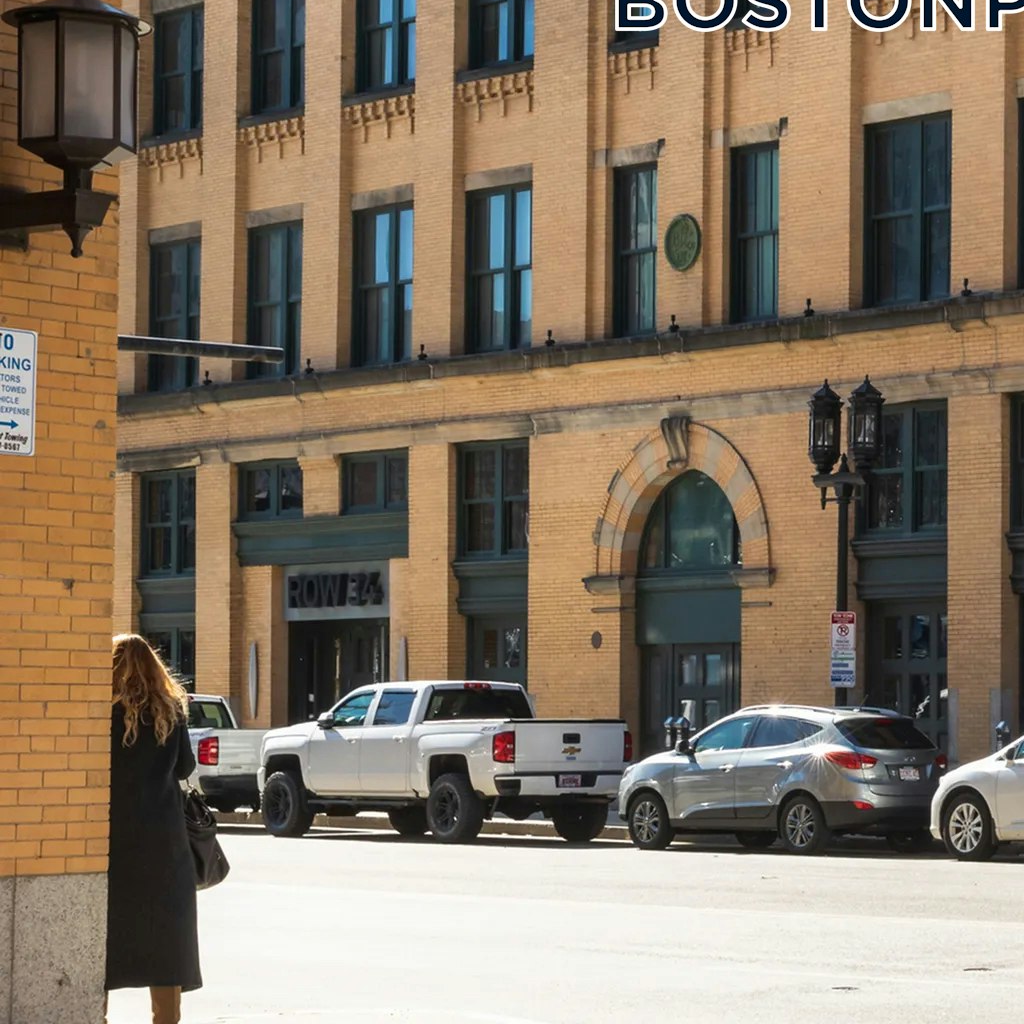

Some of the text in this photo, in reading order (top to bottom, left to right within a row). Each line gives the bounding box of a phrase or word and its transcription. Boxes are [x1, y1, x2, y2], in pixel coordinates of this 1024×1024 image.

[1, 385, 27, 395] TOWED
[0, 406, 31, 417] EXPENSE
[5, 432, 28, 445] Towing
[287, 573, 344, 608] ROW
